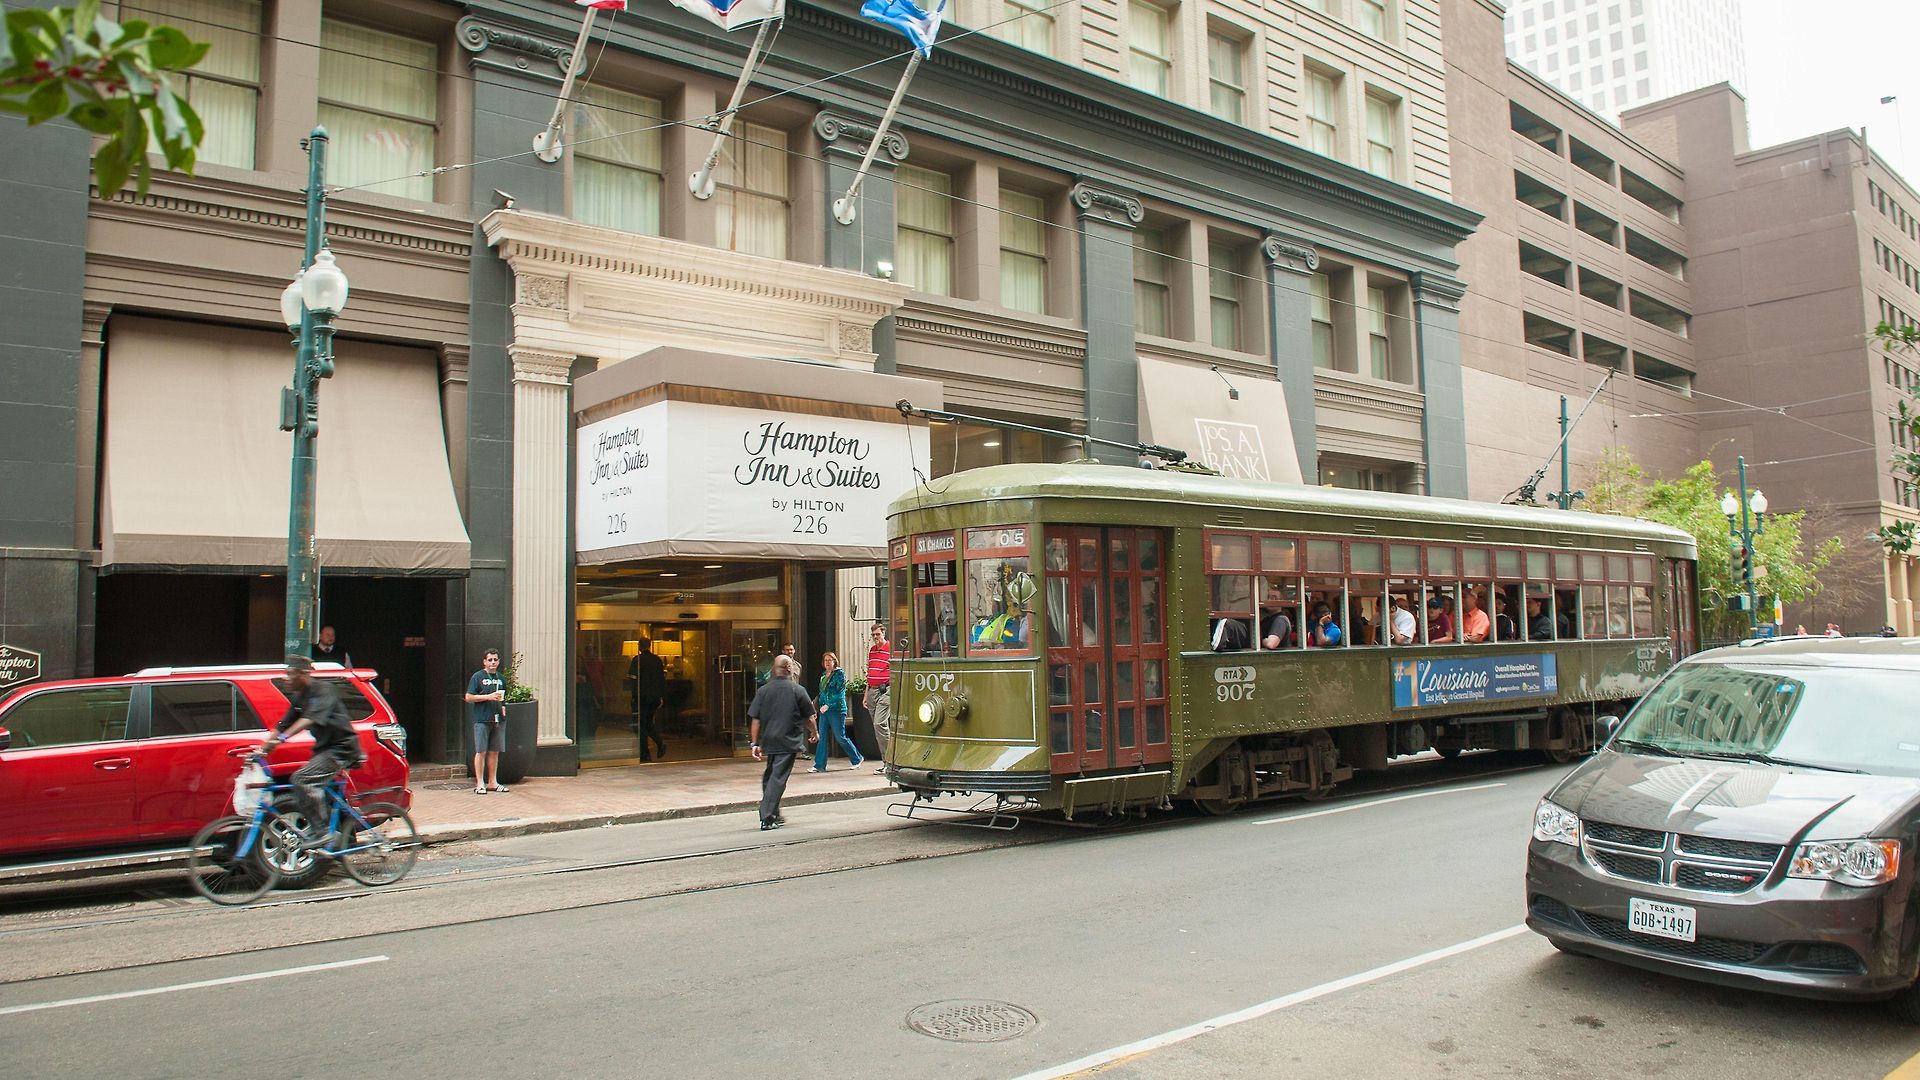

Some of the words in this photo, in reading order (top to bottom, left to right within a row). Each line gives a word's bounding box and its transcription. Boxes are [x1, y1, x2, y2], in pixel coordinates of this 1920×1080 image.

[593, 427, 645, 461] Hampton
[743, 422, 870, 461] Hampton
[590, 460, 612, 485] Inn
[611, 460, 621, 477] &
[621, 449, 649, 475] Suites
[734, 456, 800, 487] Inn
[801, 467, 817, 489] &
[816, 460, 881, 490] Suites
[1206, 452, 1267, 480] BANK
[772, 498, 788, 511] by
[793, 500, 844, 512] HILTON
[607, 512, 627, 535] 226
[793, 514, 828, 535] 226
[927, 536, 954, 551] CHARLES
[914, 673, 955, 692] 907
[1222, 670, 1238, 680] RTA
[1420, 660, 1490, 693] Louisiana
[1216, 683, 1256, 702] 907
[1649, 903, 1675, 914] TEXAS
